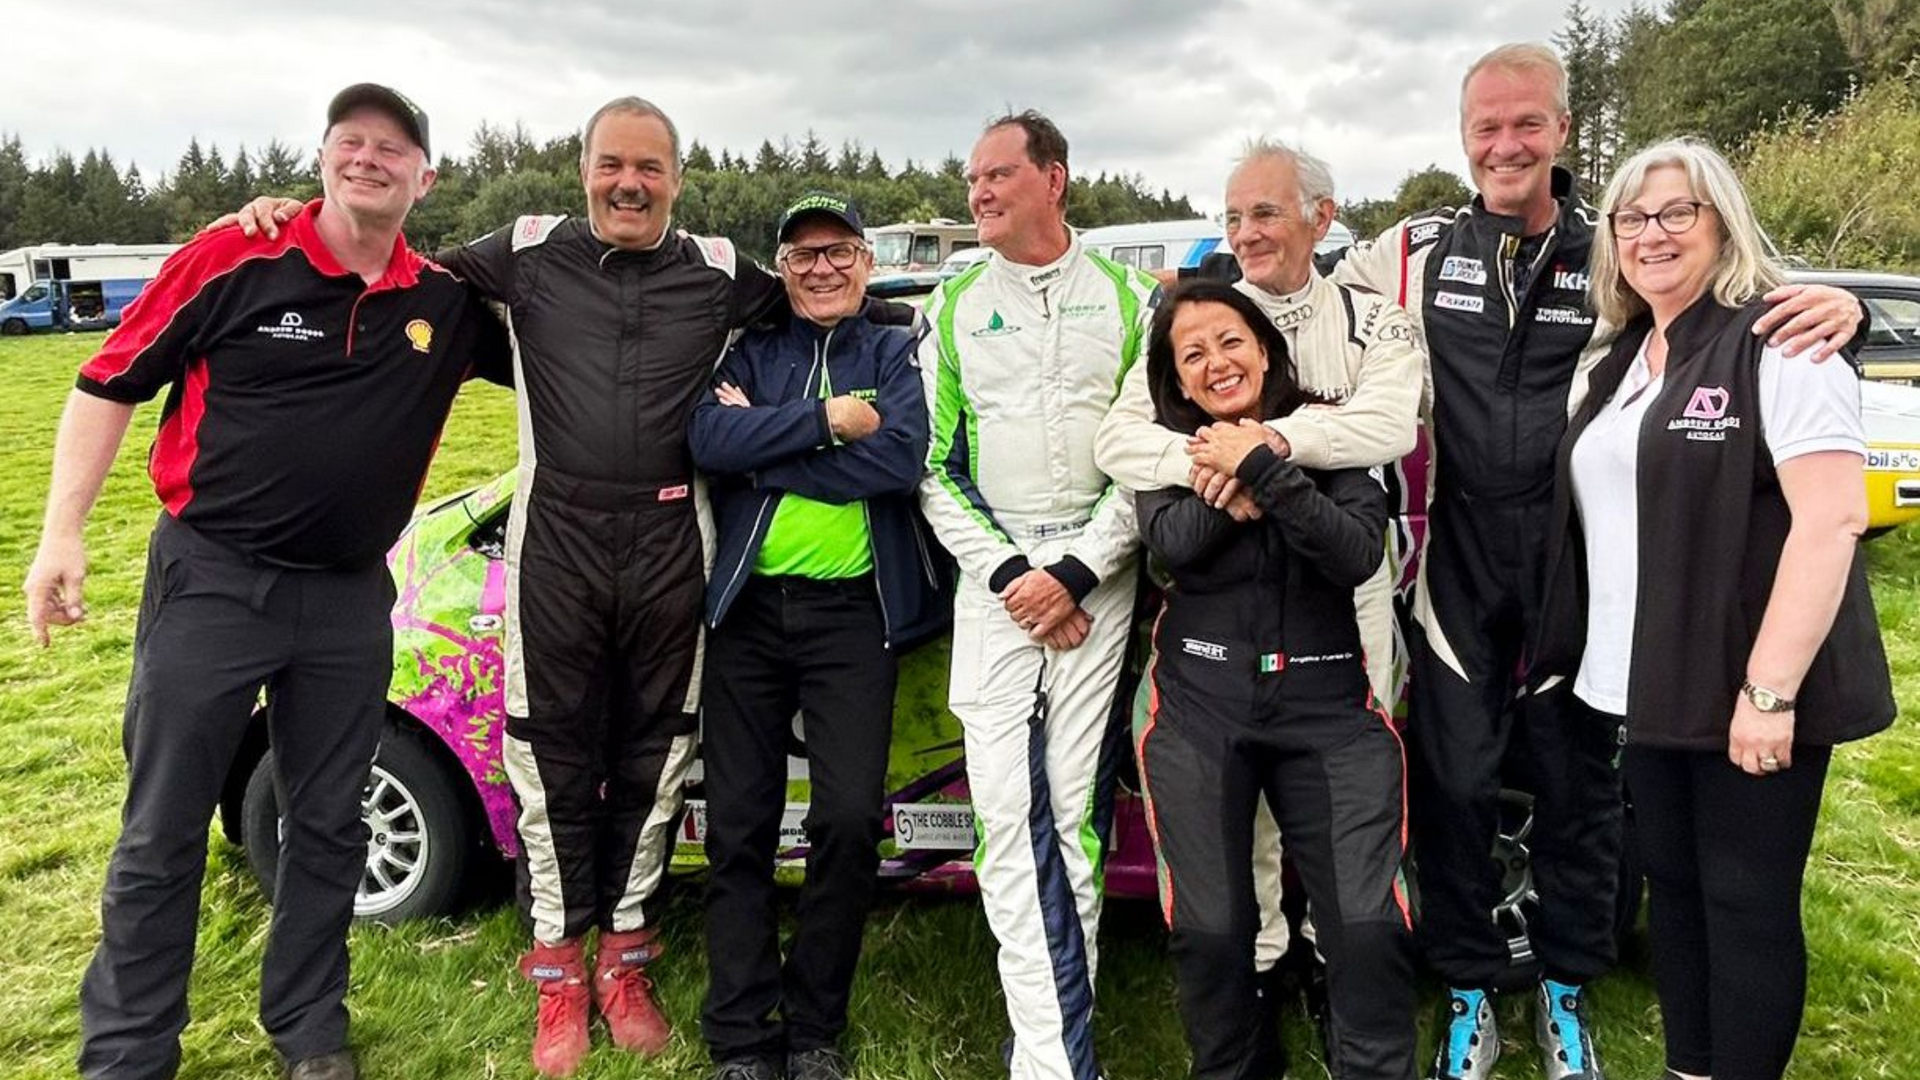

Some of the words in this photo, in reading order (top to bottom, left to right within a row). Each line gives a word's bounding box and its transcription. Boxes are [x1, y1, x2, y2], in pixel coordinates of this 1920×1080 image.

[1667, 418, 1710, 430] ANDREW
[1868, 452, 1889, 467] bil
[912, 813, 929, 828] THE
[930, 813, 963, 829] COBBLE
